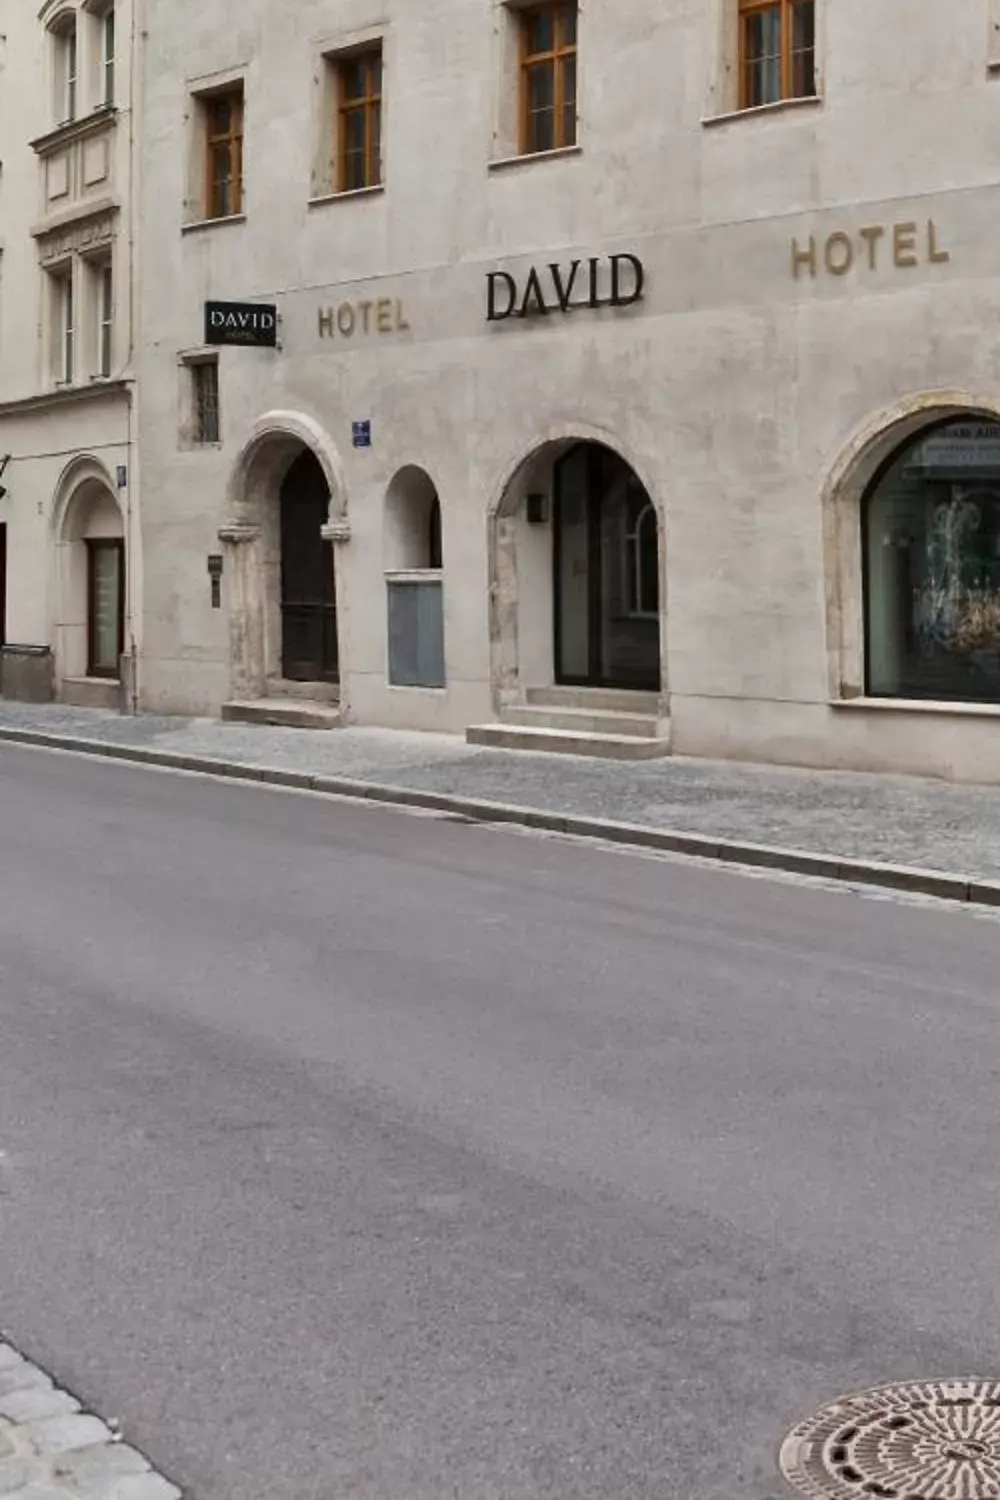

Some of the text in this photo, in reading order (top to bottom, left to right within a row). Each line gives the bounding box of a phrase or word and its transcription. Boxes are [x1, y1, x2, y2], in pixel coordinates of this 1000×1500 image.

[791, 217, 950, 281] HOTEL
[486, 253, 645, 321] DAVID
[211, 310, 274, 329] DAVID
[318, 298, 410, 339] HOTEL
